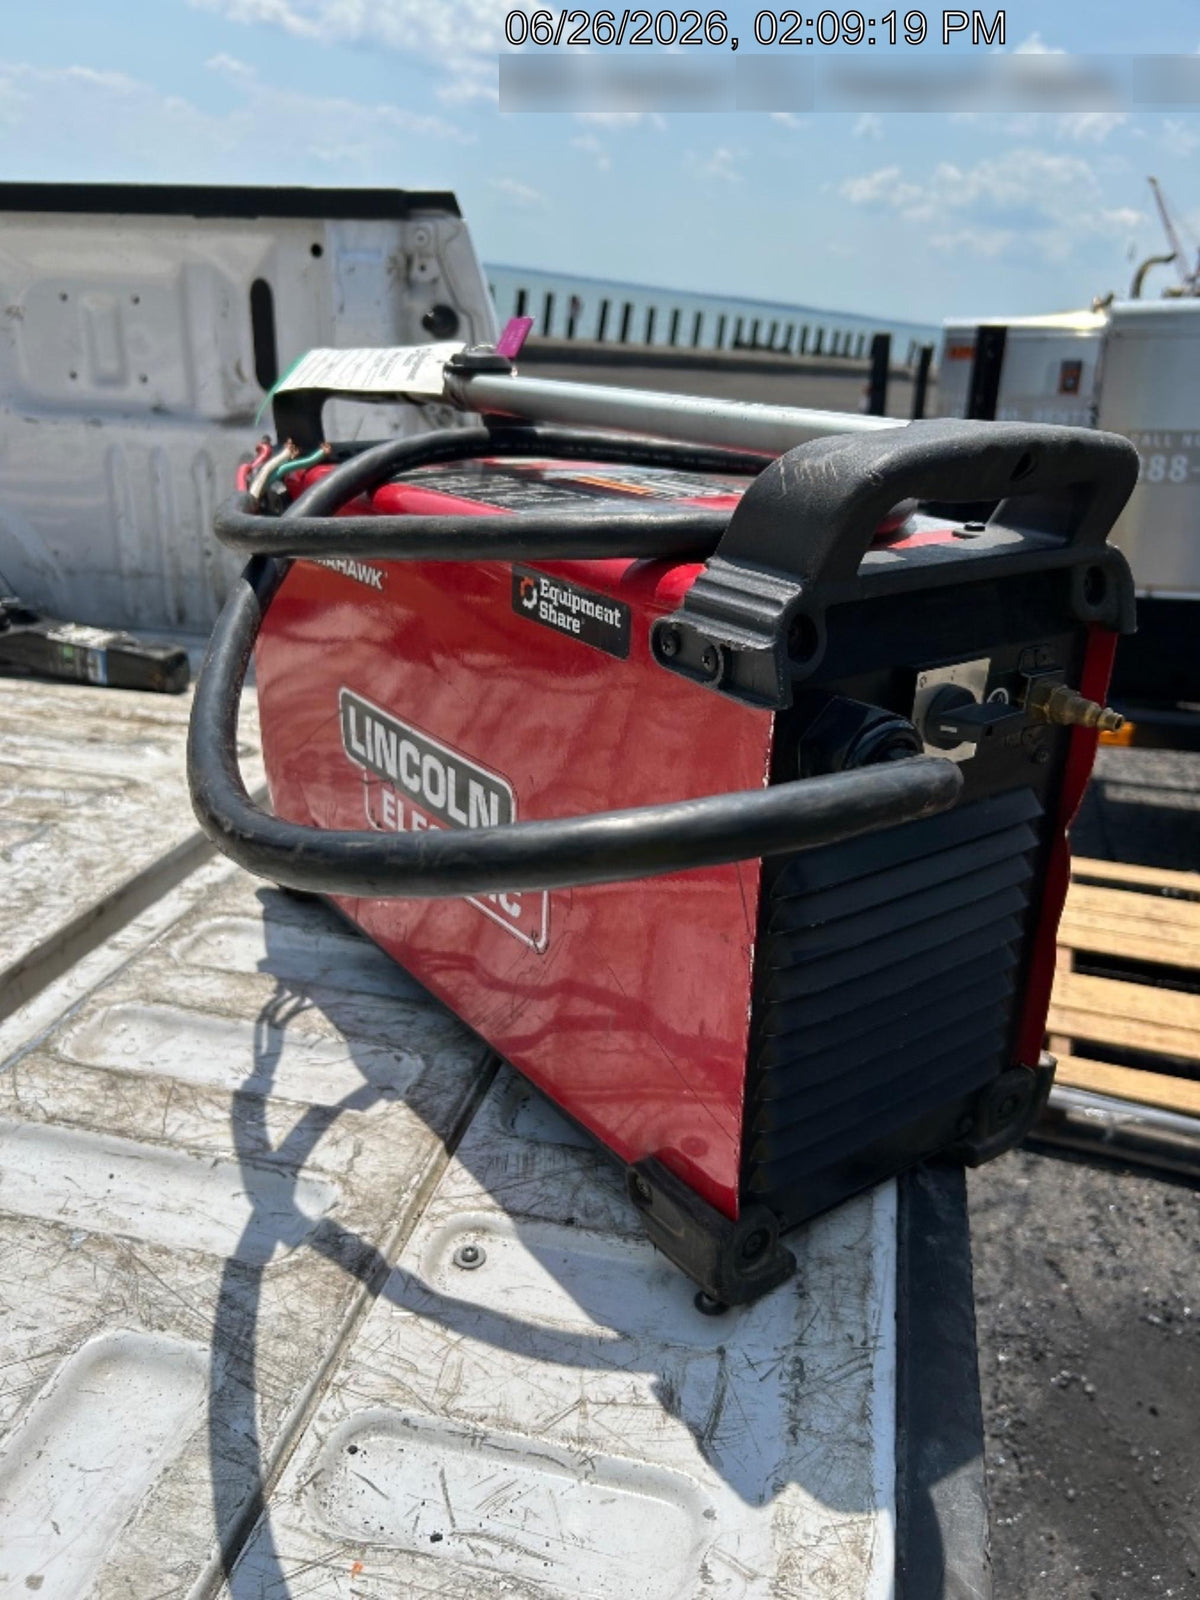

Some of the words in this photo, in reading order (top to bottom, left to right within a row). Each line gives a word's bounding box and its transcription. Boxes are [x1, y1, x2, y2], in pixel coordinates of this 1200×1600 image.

[1140, 454, 1200, 482] 88-
[539, 579, 621, 628] Equipment
[539, 600, 581, 634] Share
[348, 704, 500, 829] LINCOLN
